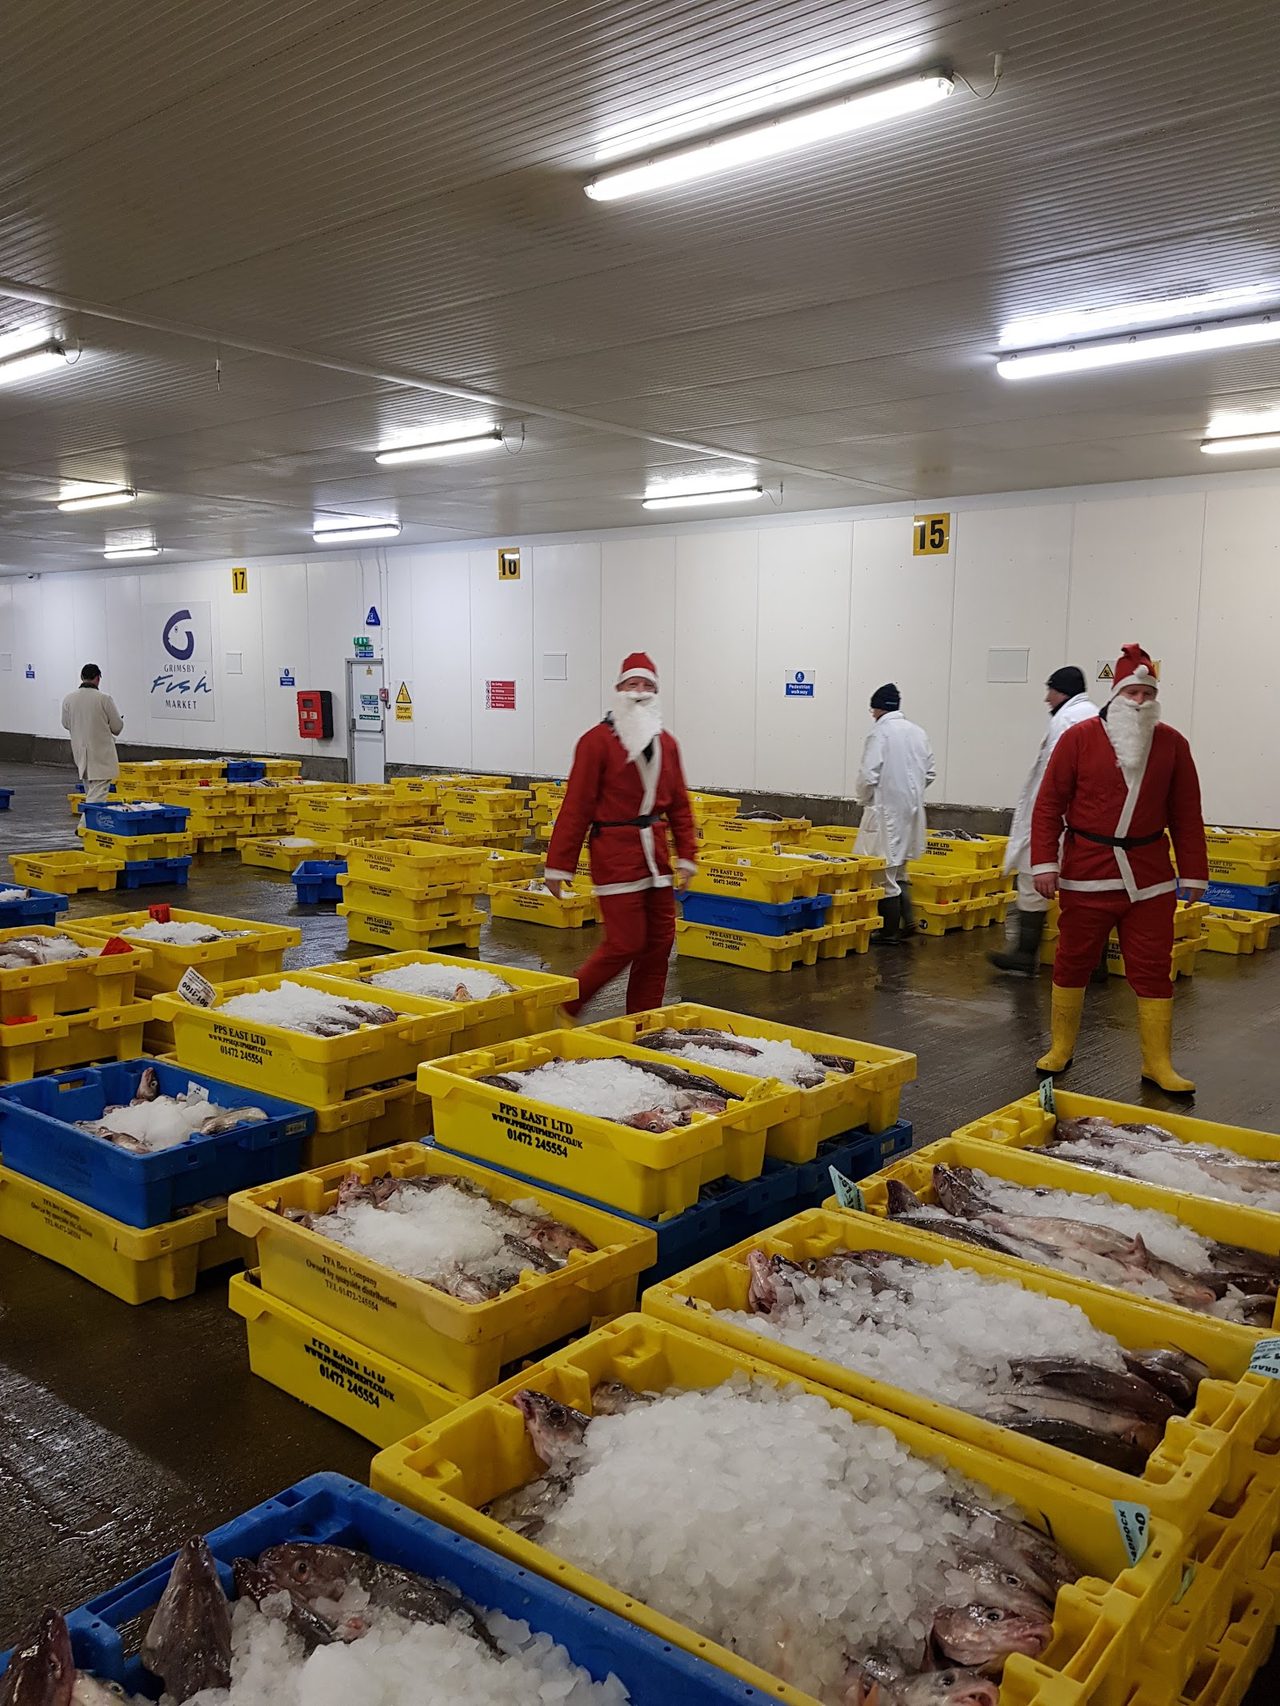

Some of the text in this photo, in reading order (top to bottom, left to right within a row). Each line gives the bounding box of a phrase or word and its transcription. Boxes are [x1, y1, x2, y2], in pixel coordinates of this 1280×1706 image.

[919, 519, 945, 549] 15
[234, 571, 245, 590] 17
[164, 664, 196, 673] GRIMSBY
[150, 673, 212, 694] Fish
[165, 699, 198, 710] MARKET
[720, 868, 732, 876] EAST
[213, 1023, 266, 1046] PPS EAST LTD
[220, 1045, 263, 1065] 01472 245554
[499, 1101, 573, 1135] PPS EAST LTD
[507, 1127, 568, 1158] 01472 245554
[322, 1254, 377, 1288] TFA Box Company
[305, 1259, 397, 1309] Owned by quayside distribution
[319, 1363, 380, 1408] 01472 245554
